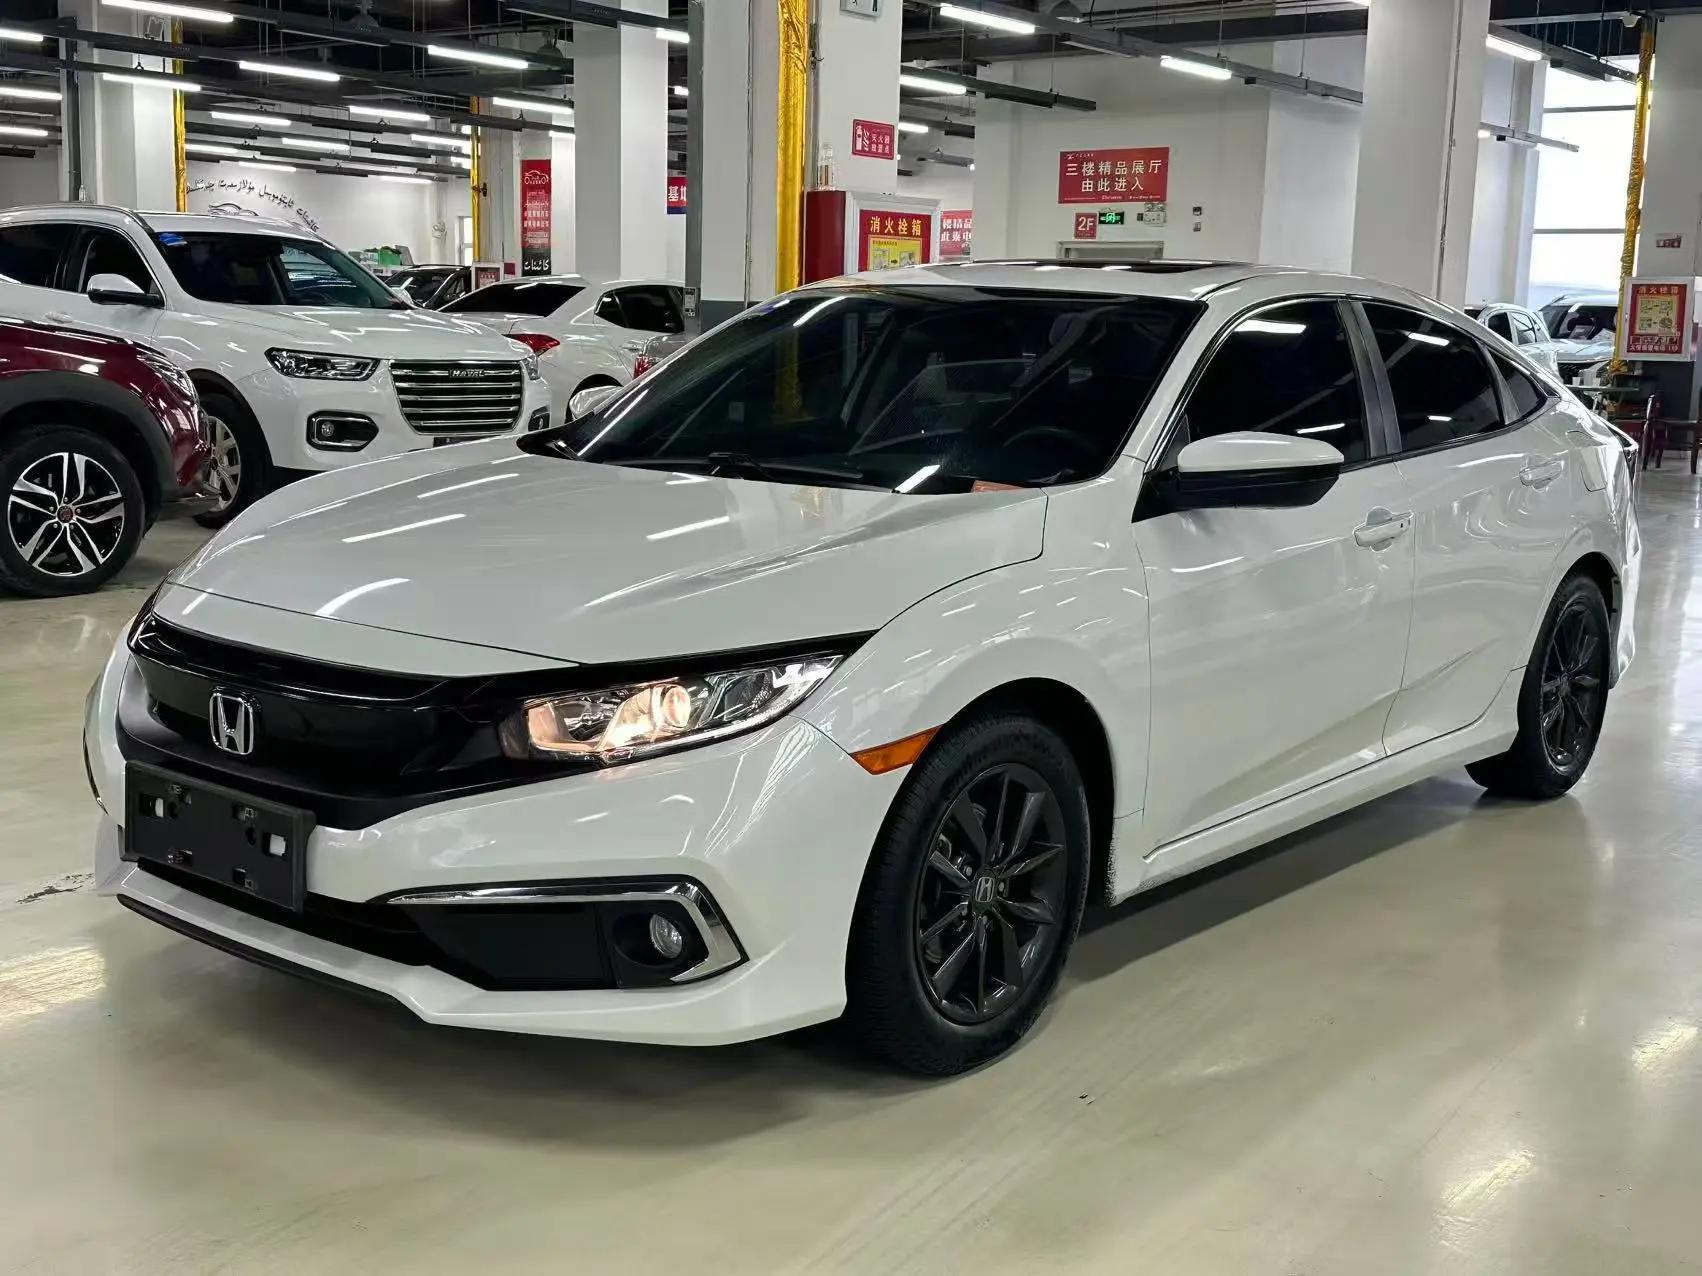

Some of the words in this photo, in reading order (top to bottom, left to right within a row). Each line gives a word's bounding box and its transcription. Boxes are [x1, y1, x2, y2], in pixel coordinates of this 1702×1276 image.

[1066, 160, 1162, 176] 三楼精品展厅
[1081, 177, 1144, 192] 由此进入
[870, 216, 922, 236] 消火栓箱
[1078, 217, 1095, 231] 2F
